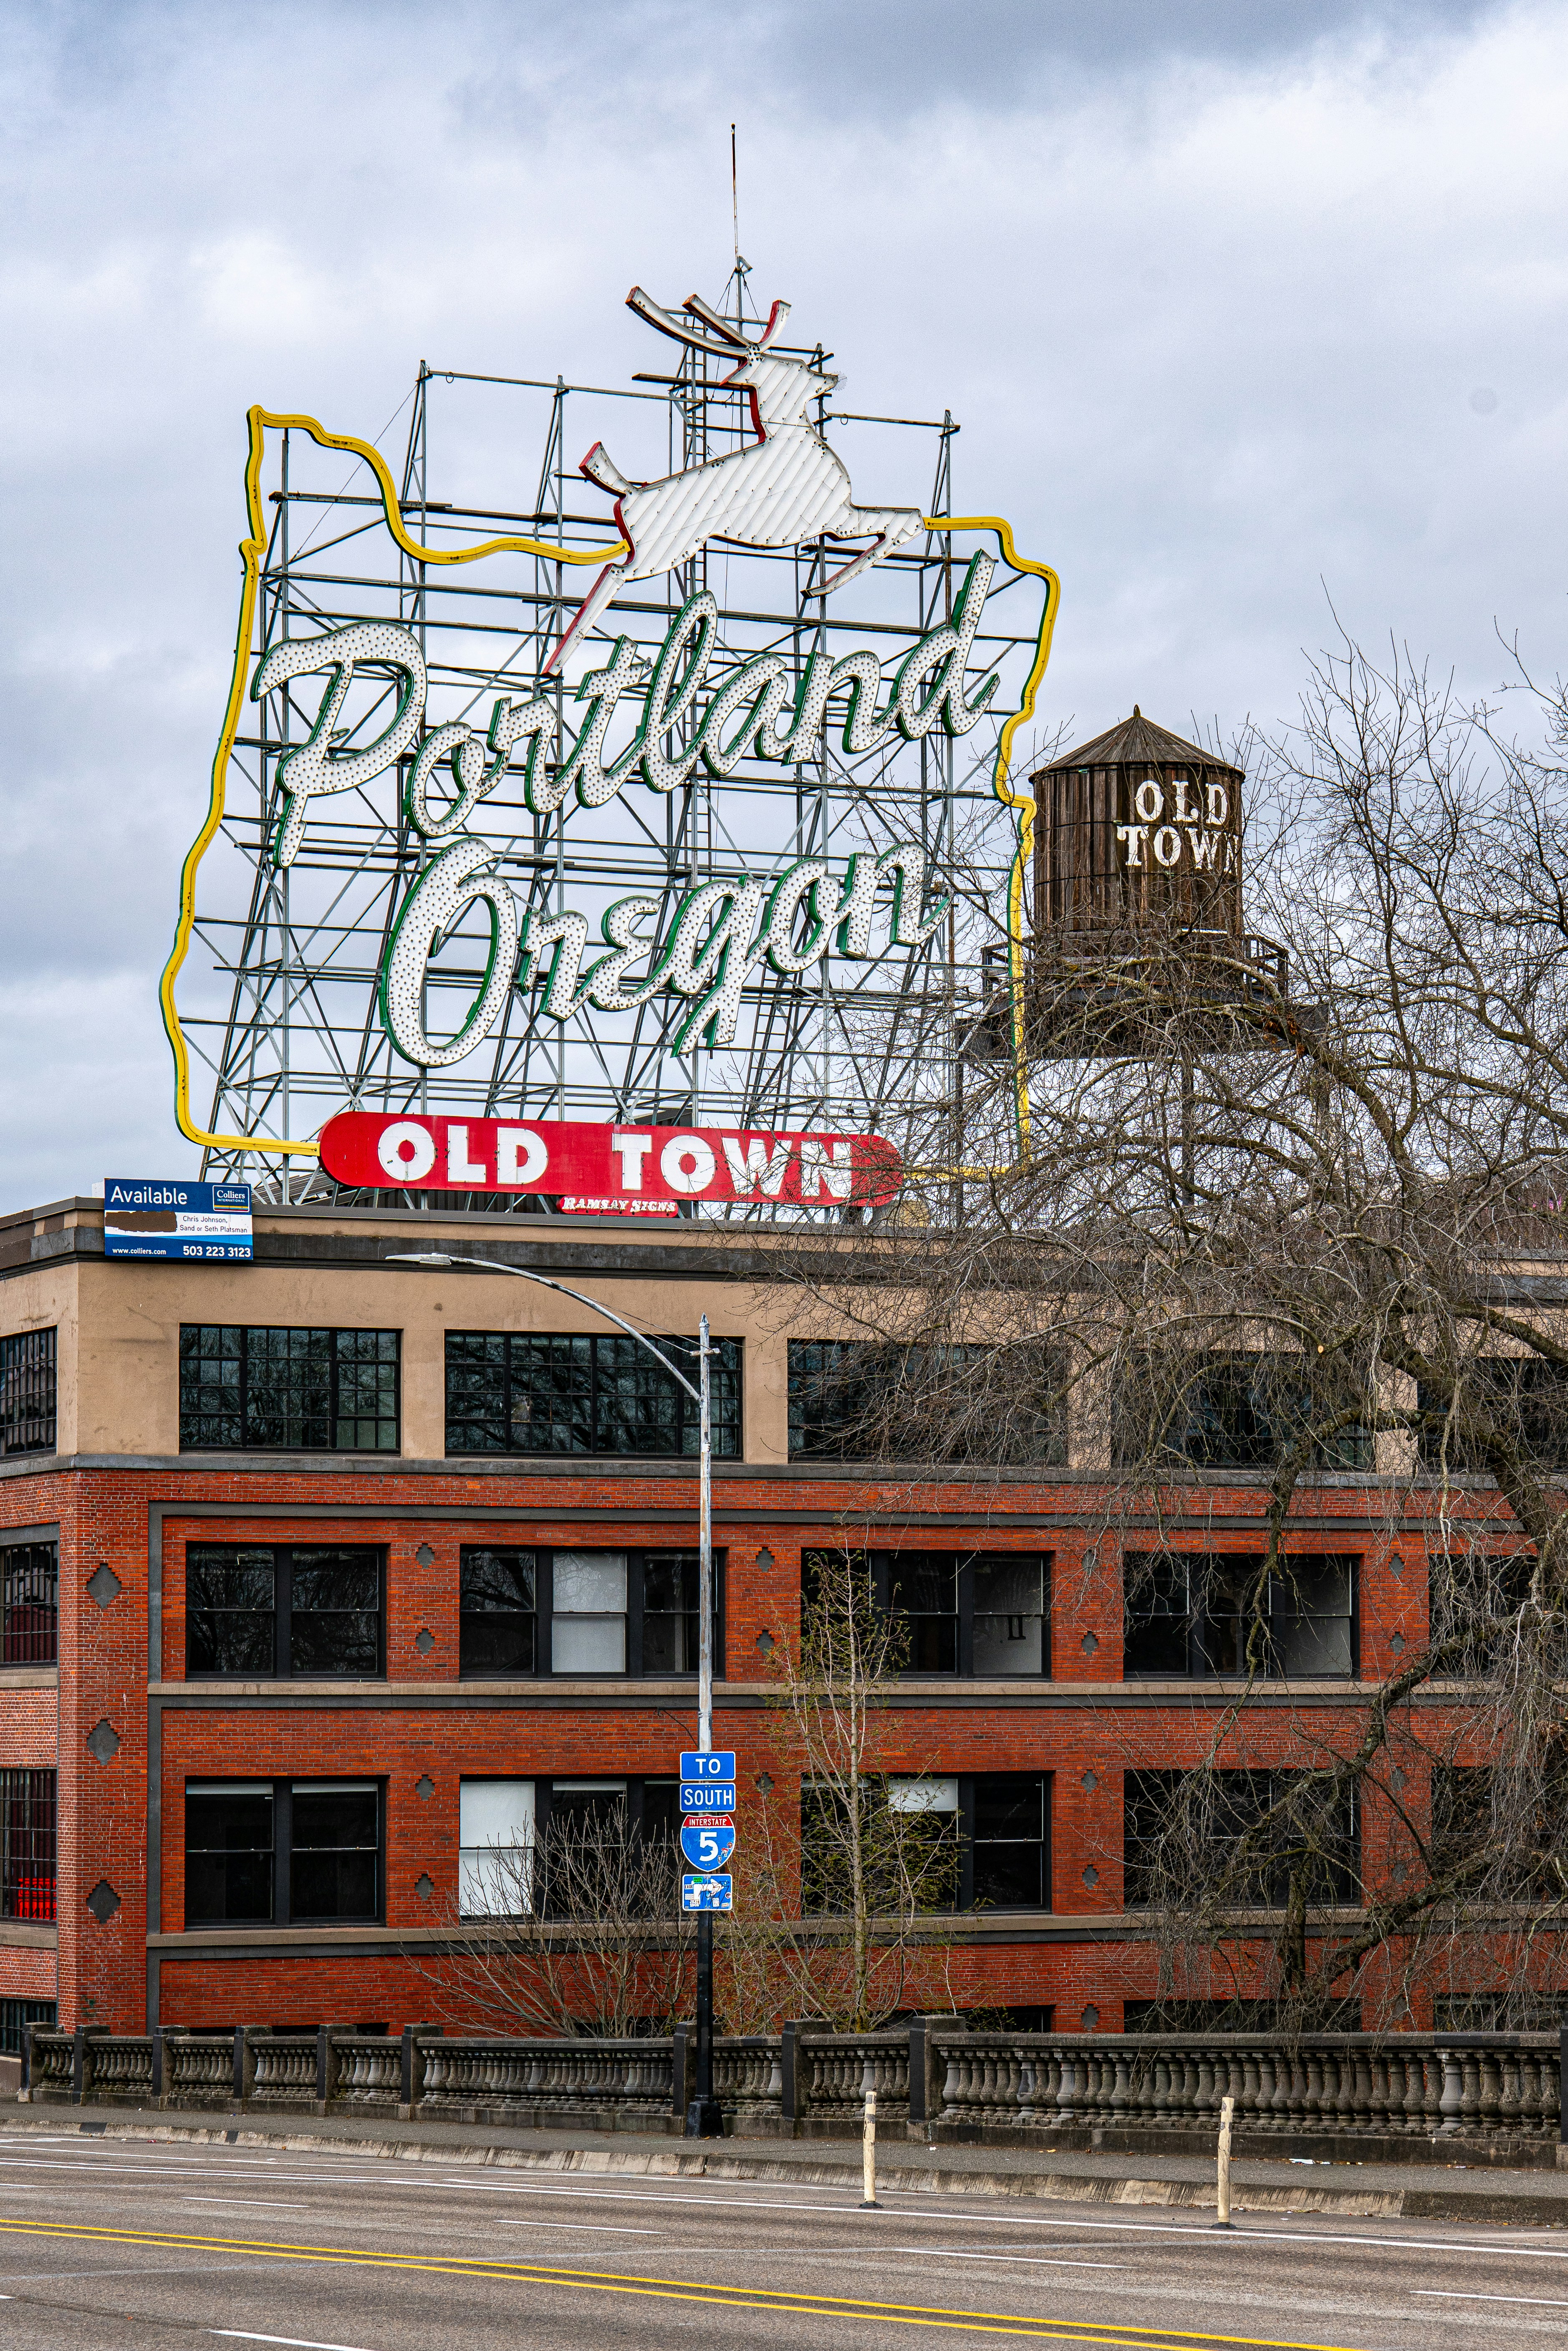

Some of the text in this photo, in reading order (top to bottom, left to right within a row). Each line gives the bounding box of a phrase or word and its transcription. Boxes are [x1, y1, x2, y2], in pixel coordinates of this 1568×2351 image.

[250, 548, 1000, 869] Portland
[1134, 780, 1228, 825] OLD
[378, 836, 951, 1068] Oregon
[377, 1121, 851, 1198] OLD TOWN
[110, 1186, 188, 1205] Available
[217, 1190, 245, 1199] Colliers
[562, 1197, 676, 1213] RAMSAY SIGNS
[183, 1246, 251, 1258] 503 223 3123
[695, 1758, 721, 1774] TO
[684, 1788, 732, 1806] SOUTH
[699, 1832, 719, 1862] 5
